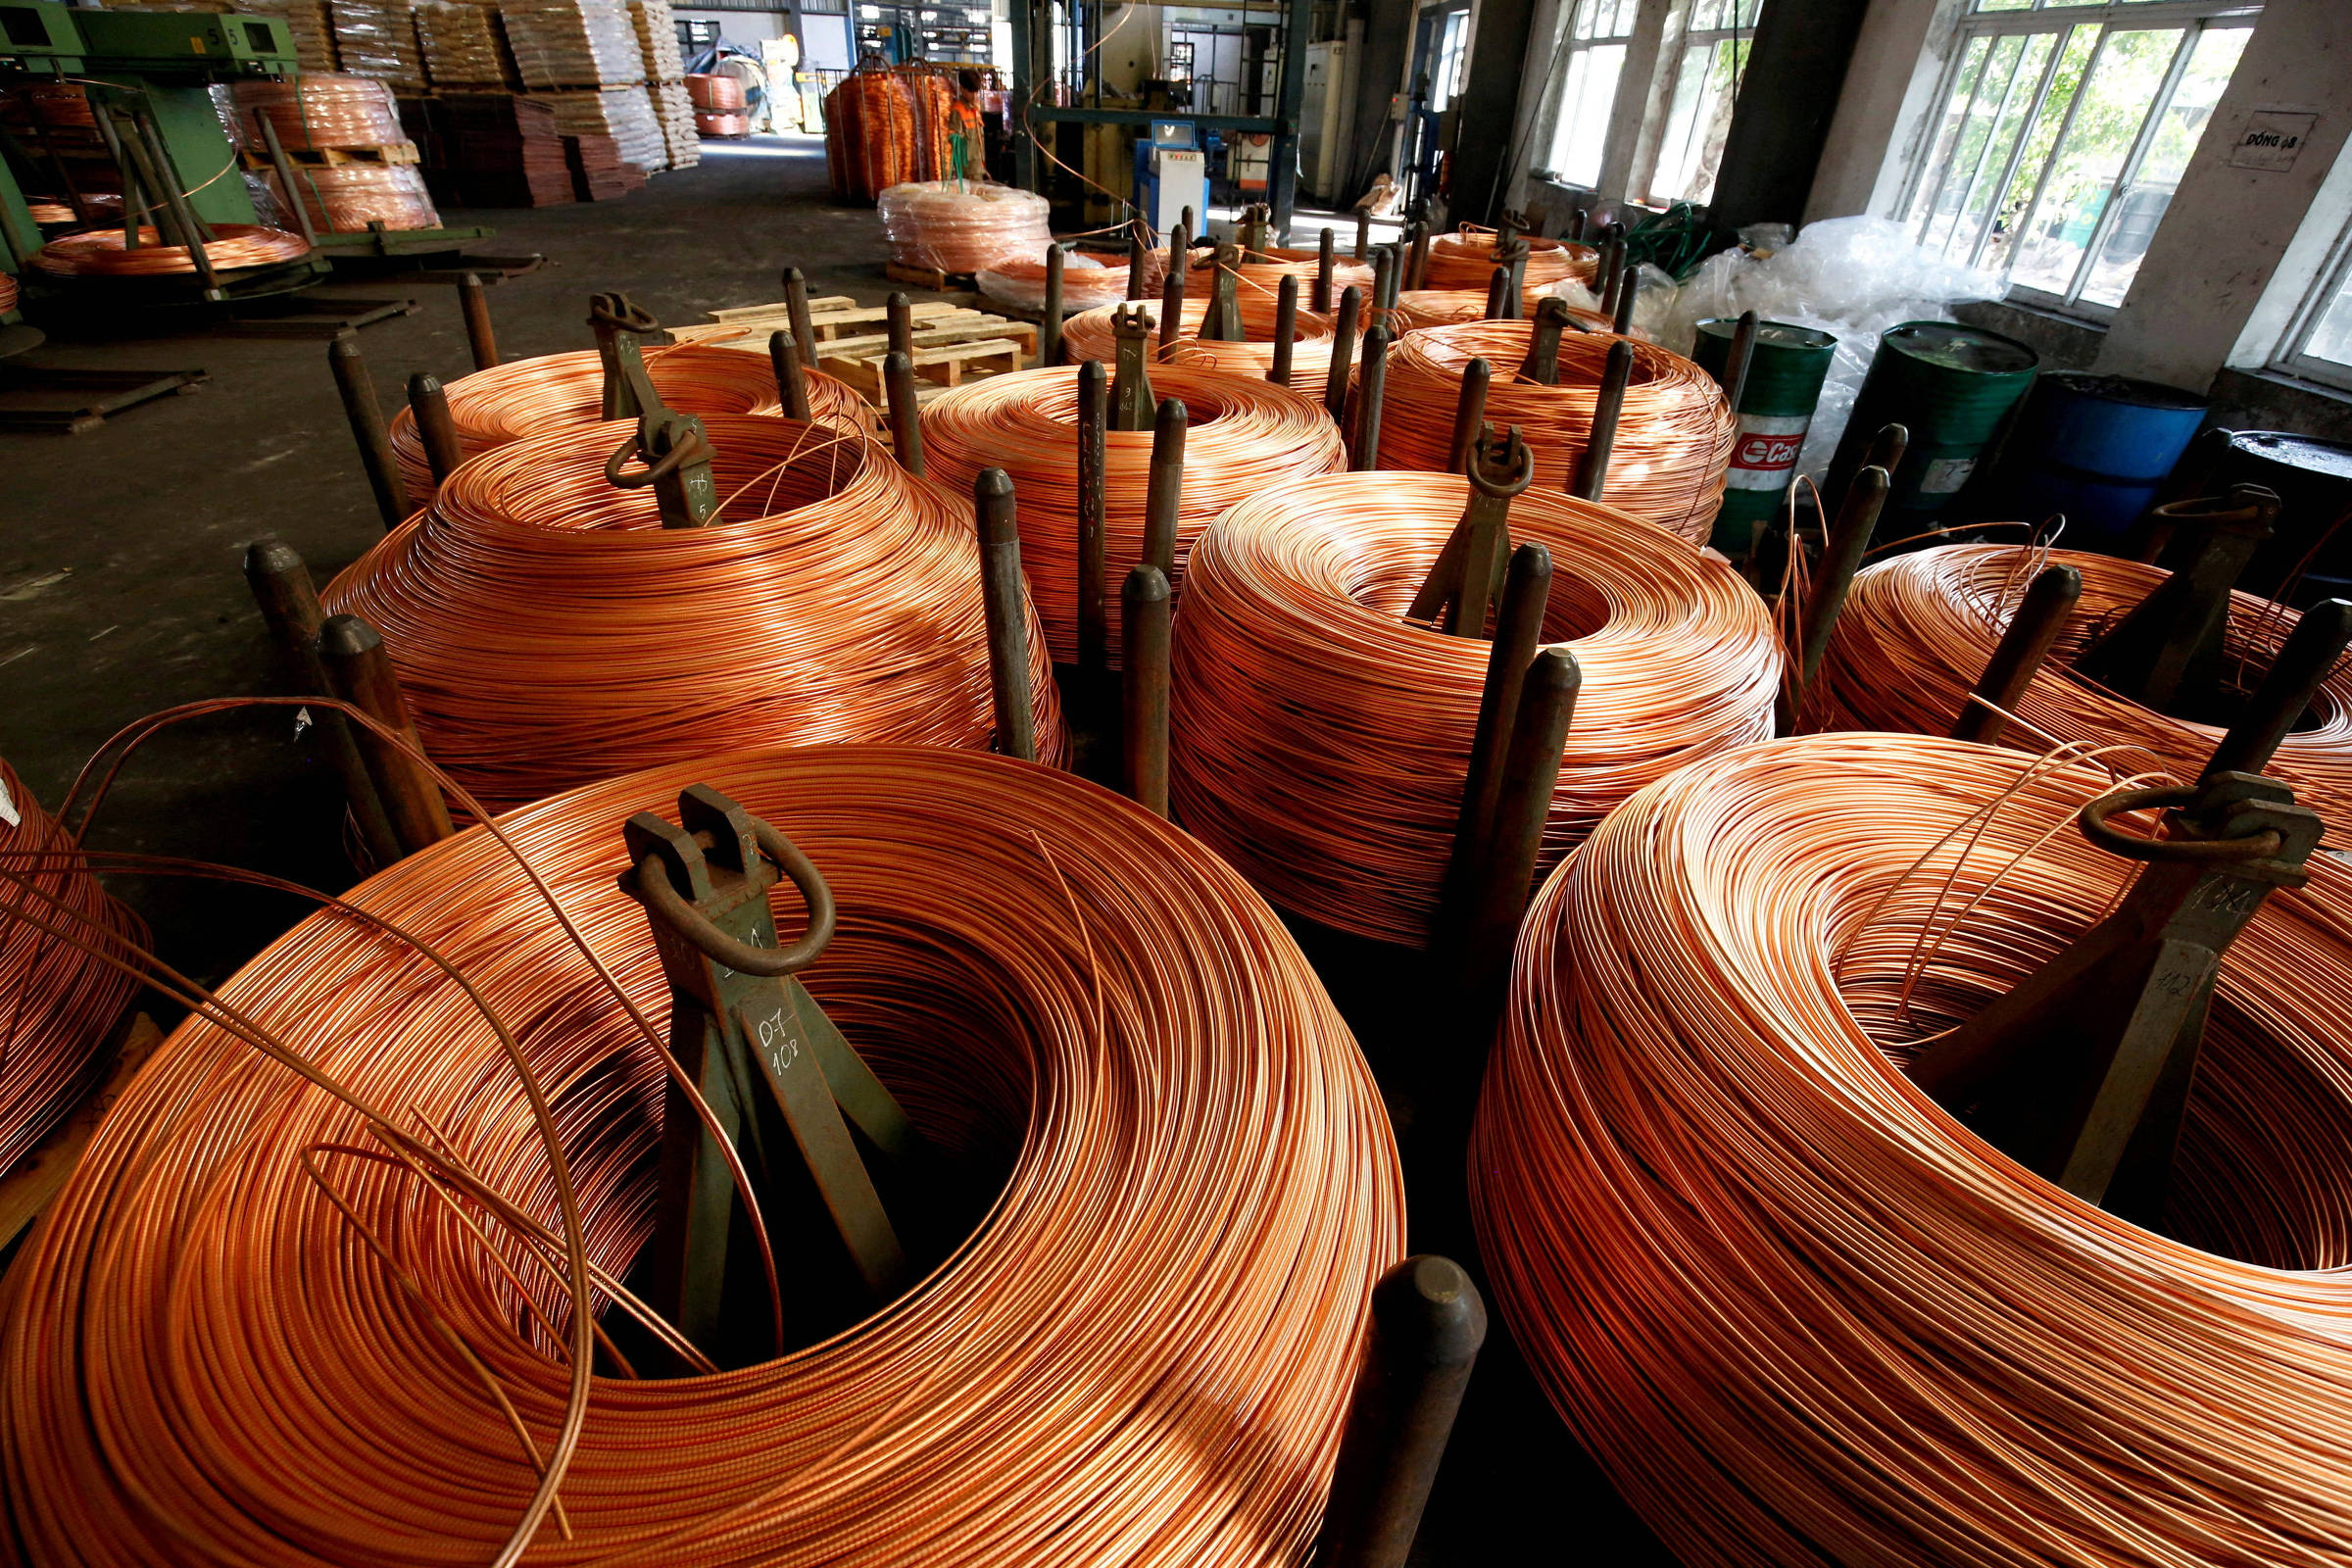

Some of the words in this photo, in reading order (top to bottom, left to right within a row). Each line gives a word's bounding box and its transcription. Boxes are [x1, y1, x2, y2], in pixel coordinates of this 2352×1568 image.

[207, 27, 220, 45] 5
[227, 28, 238, 45] 5
[1766, 441, 1800, 464] Cas
[772, 1039, 799, 1076] 108
